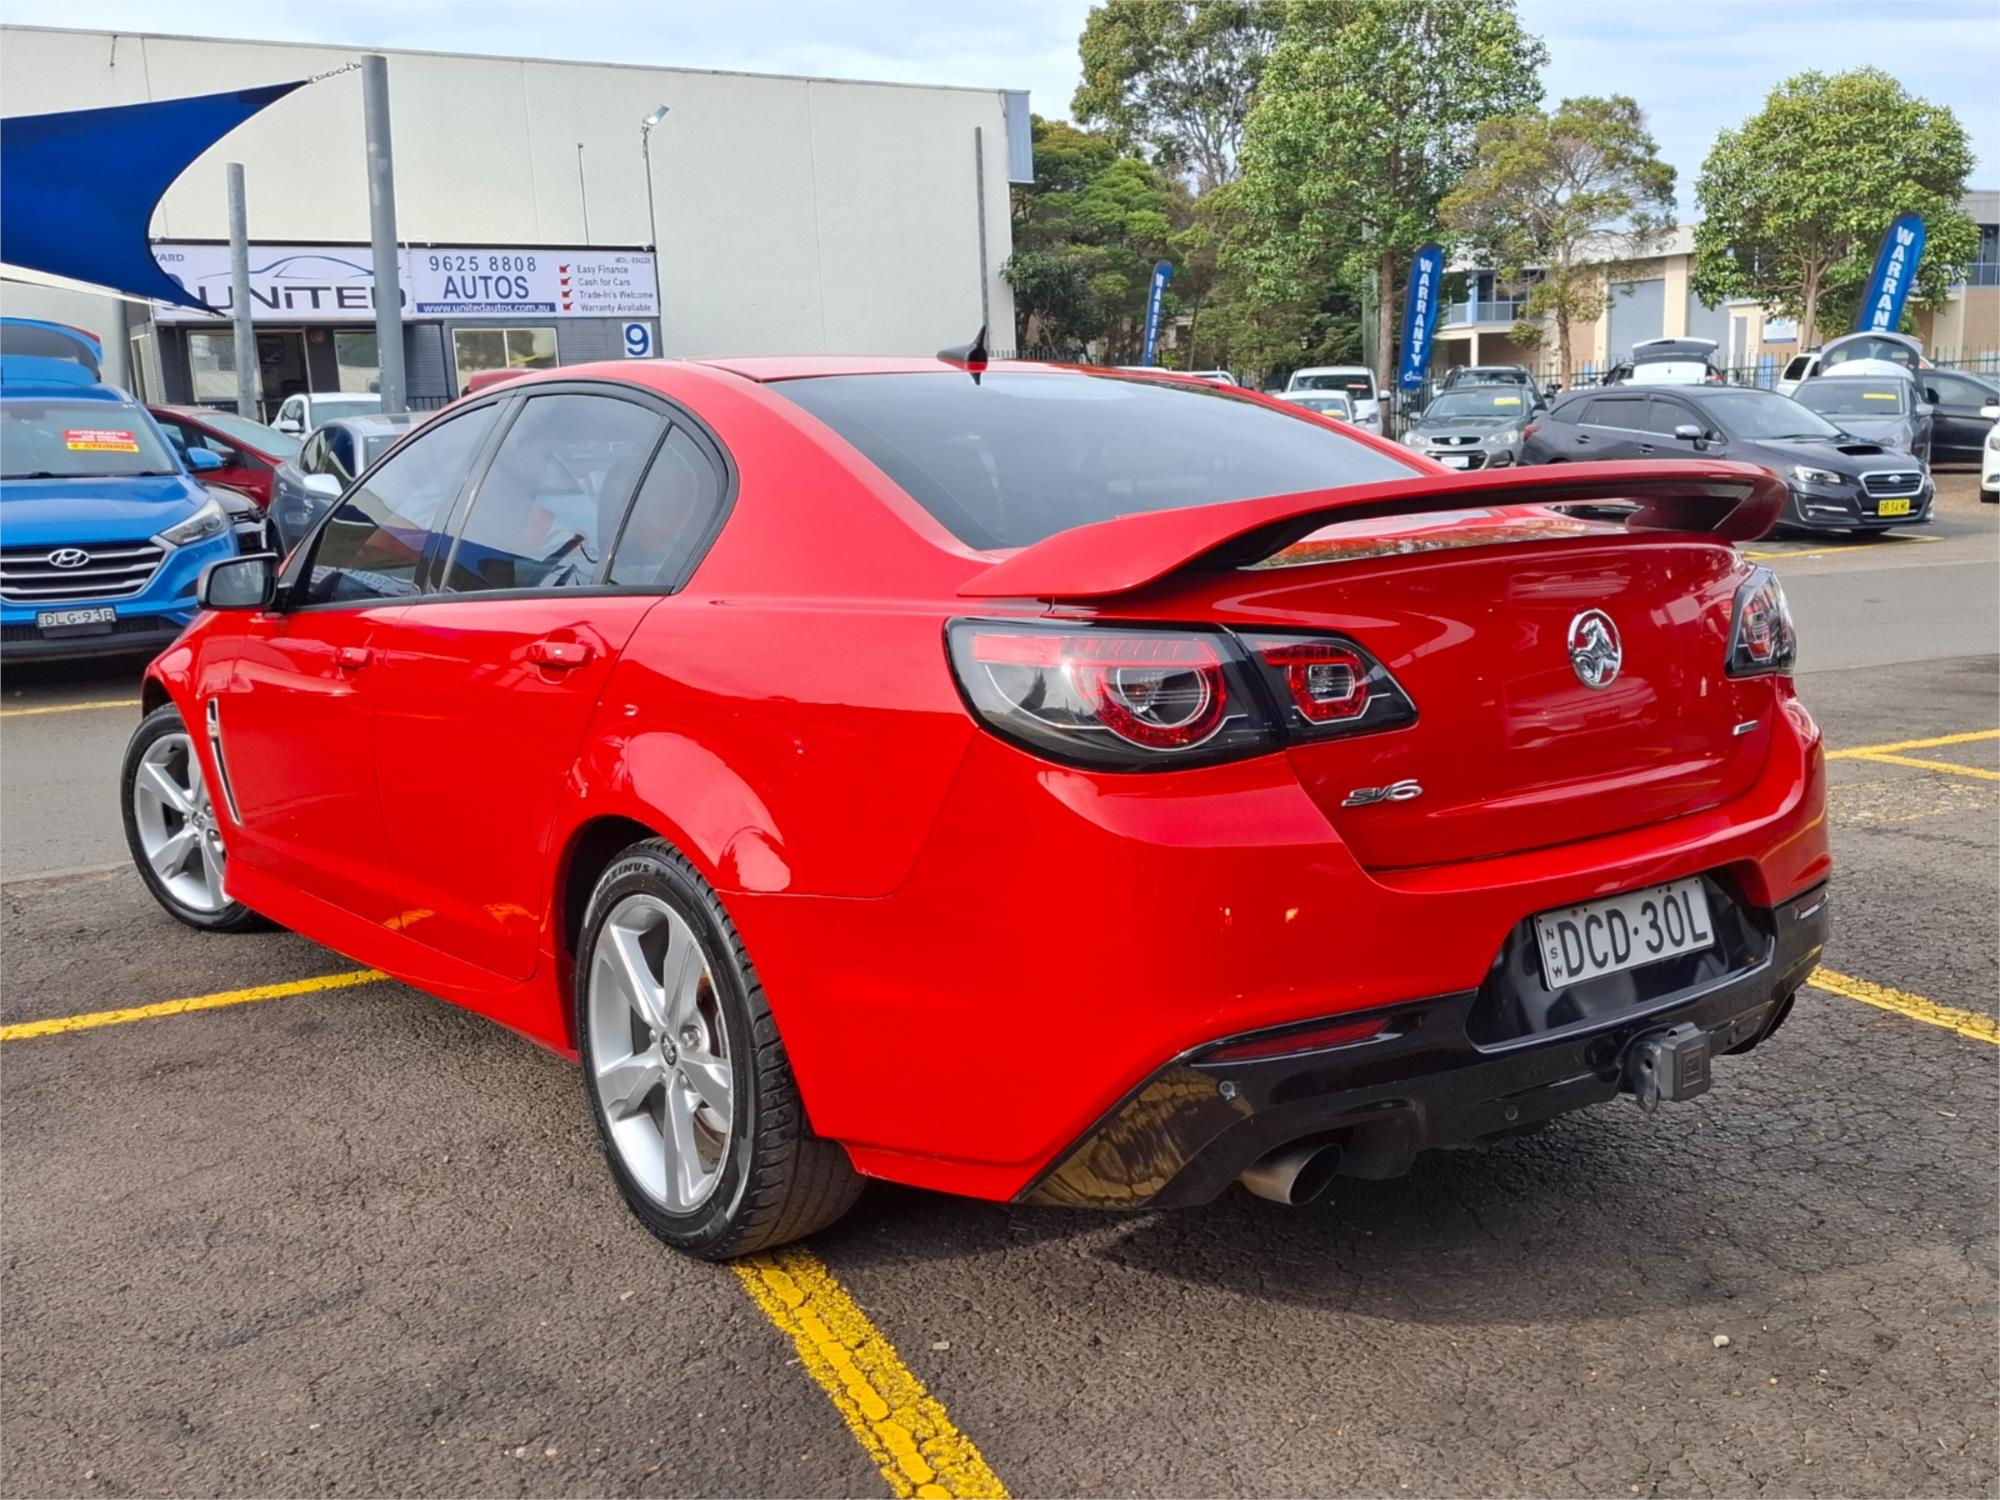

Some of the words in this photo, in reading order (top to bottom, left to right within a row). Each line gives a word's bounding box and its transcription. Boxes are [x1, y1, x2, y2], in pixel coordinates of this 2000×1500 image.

[428, 255, 479, 272] 9625
[488, 256, 537, 273] 8808
[577, 265, 596, 275] Easy
[600, 265, 628, 273] Finance
[443, 275, 530, 299] AUTOS
[578, 278, 598, 286] Cash
[600, 278, 611, 286] for
[613, 278, 631, 286] Cars
[579, 291, 617, 299] Trade-In's
[619, 291, 654, 299] Welcome
[422, 302, 551, 313] www.unitedautos.com.au
[580, 304, 615, 313] Warranty
[617, 304, 652, 312] Available
[1411, 258, 1433, 367] WARRANTY
[624, 323, 650, 356] 9
[1341, 779, 1423, 807] SV6
[1545, 928, 1563, 978] NSW
